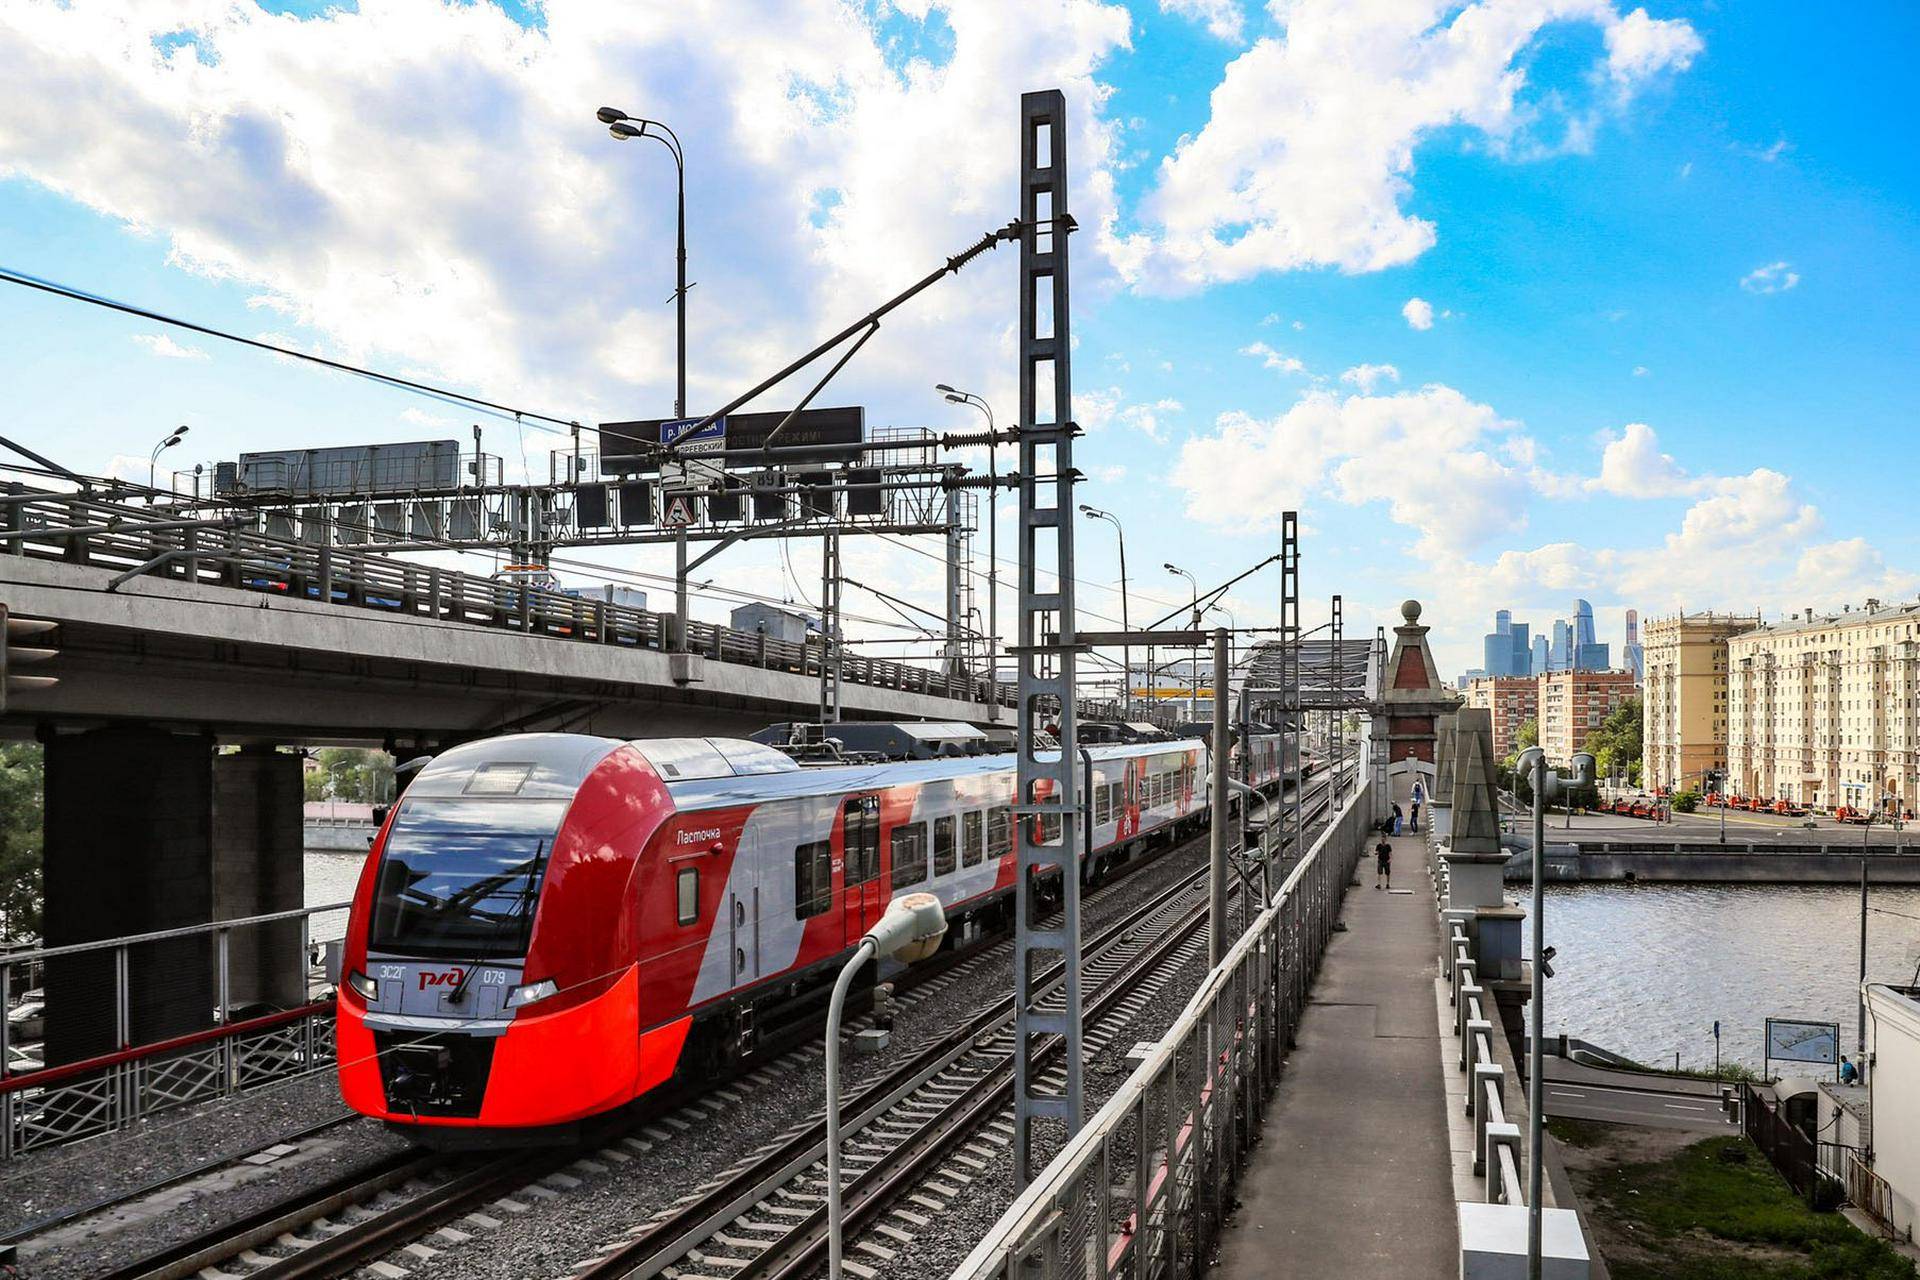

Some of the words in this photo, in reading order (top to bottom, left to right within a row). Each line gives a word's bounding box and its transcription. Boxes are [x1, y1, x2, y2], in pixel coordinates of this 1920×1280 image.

[677, 827, 721, 846] Ласточка
[380, 965, 406, 979] ЭС2Г
[483, 970, 506, 984] 079
